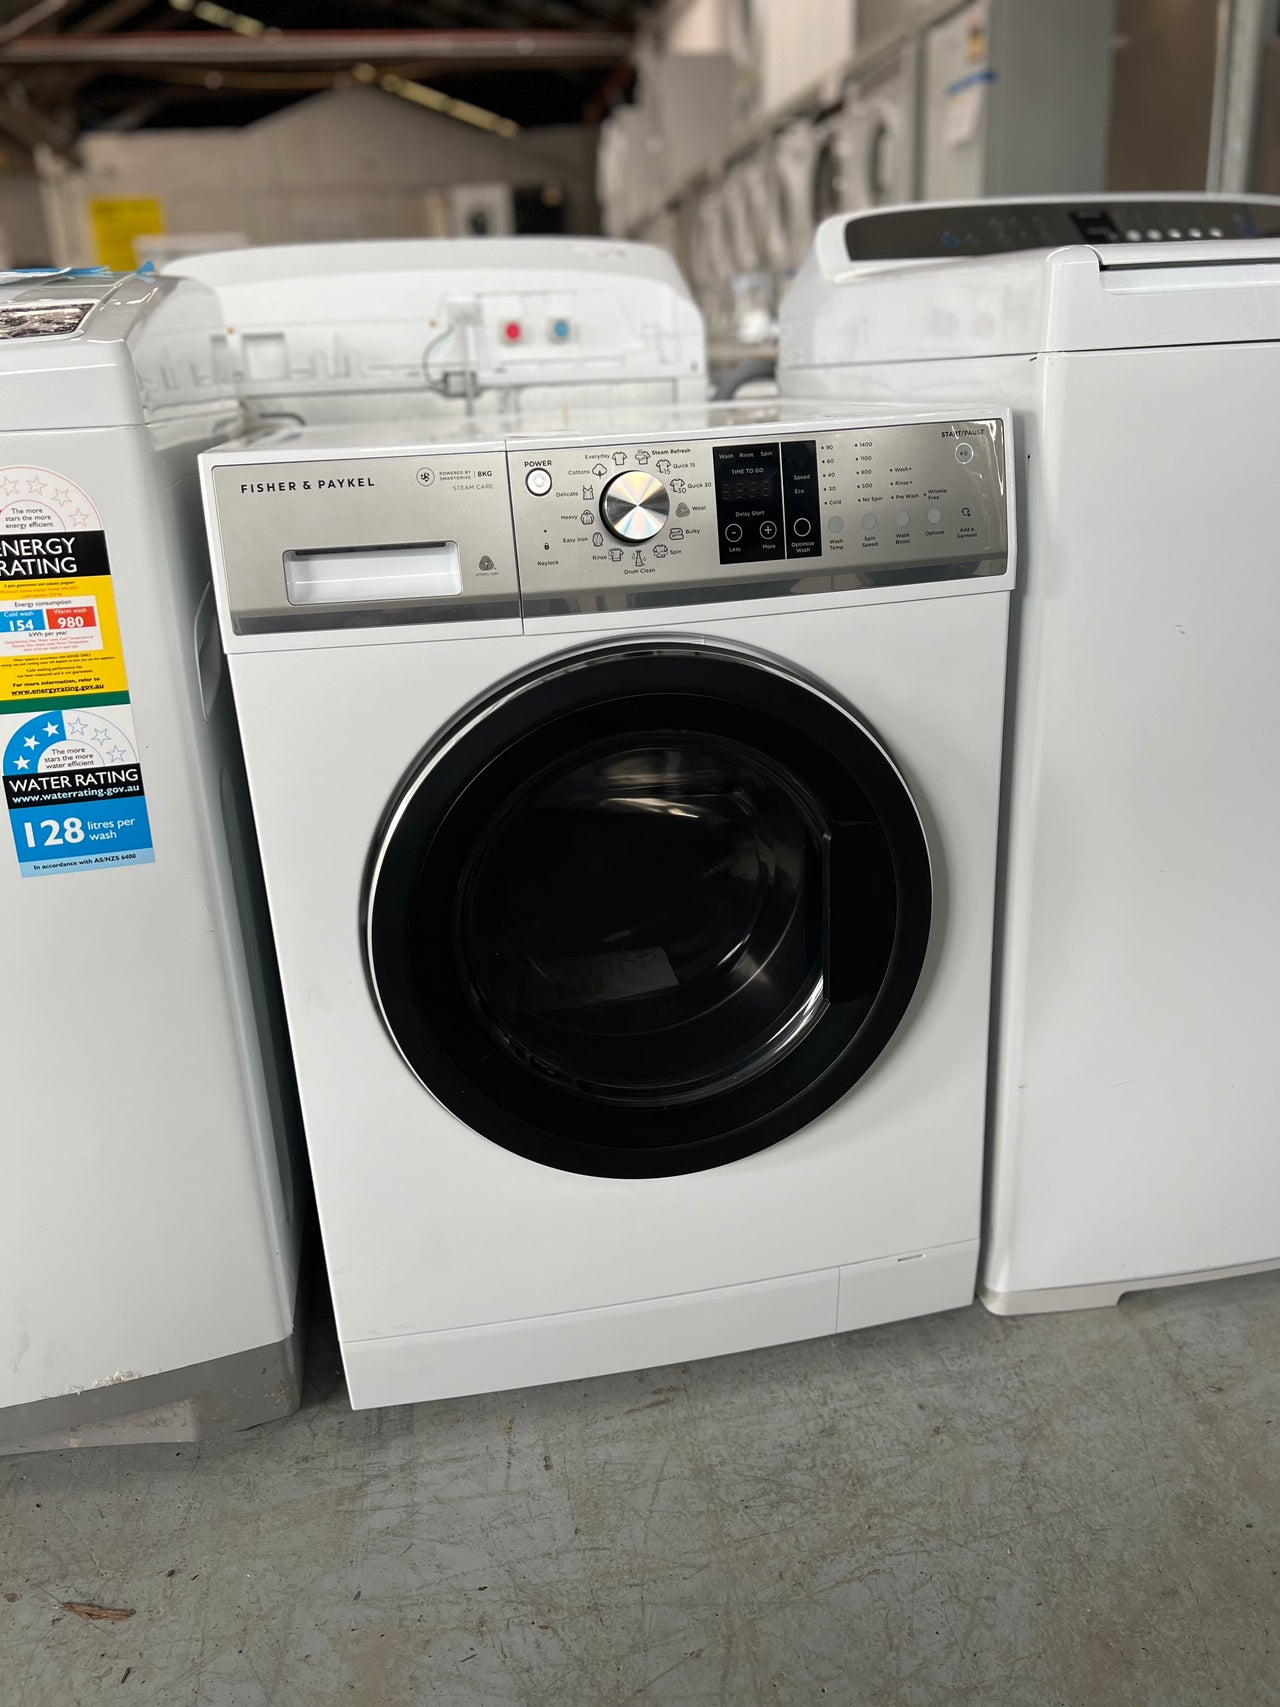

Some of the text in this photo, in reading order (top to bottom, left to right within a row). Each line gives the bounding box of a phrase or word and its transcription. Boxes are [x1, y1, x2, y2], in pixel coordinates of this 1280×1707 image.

[941, 429, 984, 437] START/PAUSE
[241, 478, 375, 493] FISHER & PAYKEL
[0, 537, 75, 557] NERGY
[0, 557, 78, 577] RATING
[9, 619, 34, 632] 154
[57, 616, 84, 628] 980
[11, 684, 104, 696] www.energyrating.gov.au
[9, 768, 139, 792] WATER RATING
[12, 785, 140, 804] www.waterrating.gov.au
[88, 818, 136, 830] litres per
[24, 817, 85, 848] 128
[89, 830, 117, 841] wash
[42, 861, 77, 870] accordance
